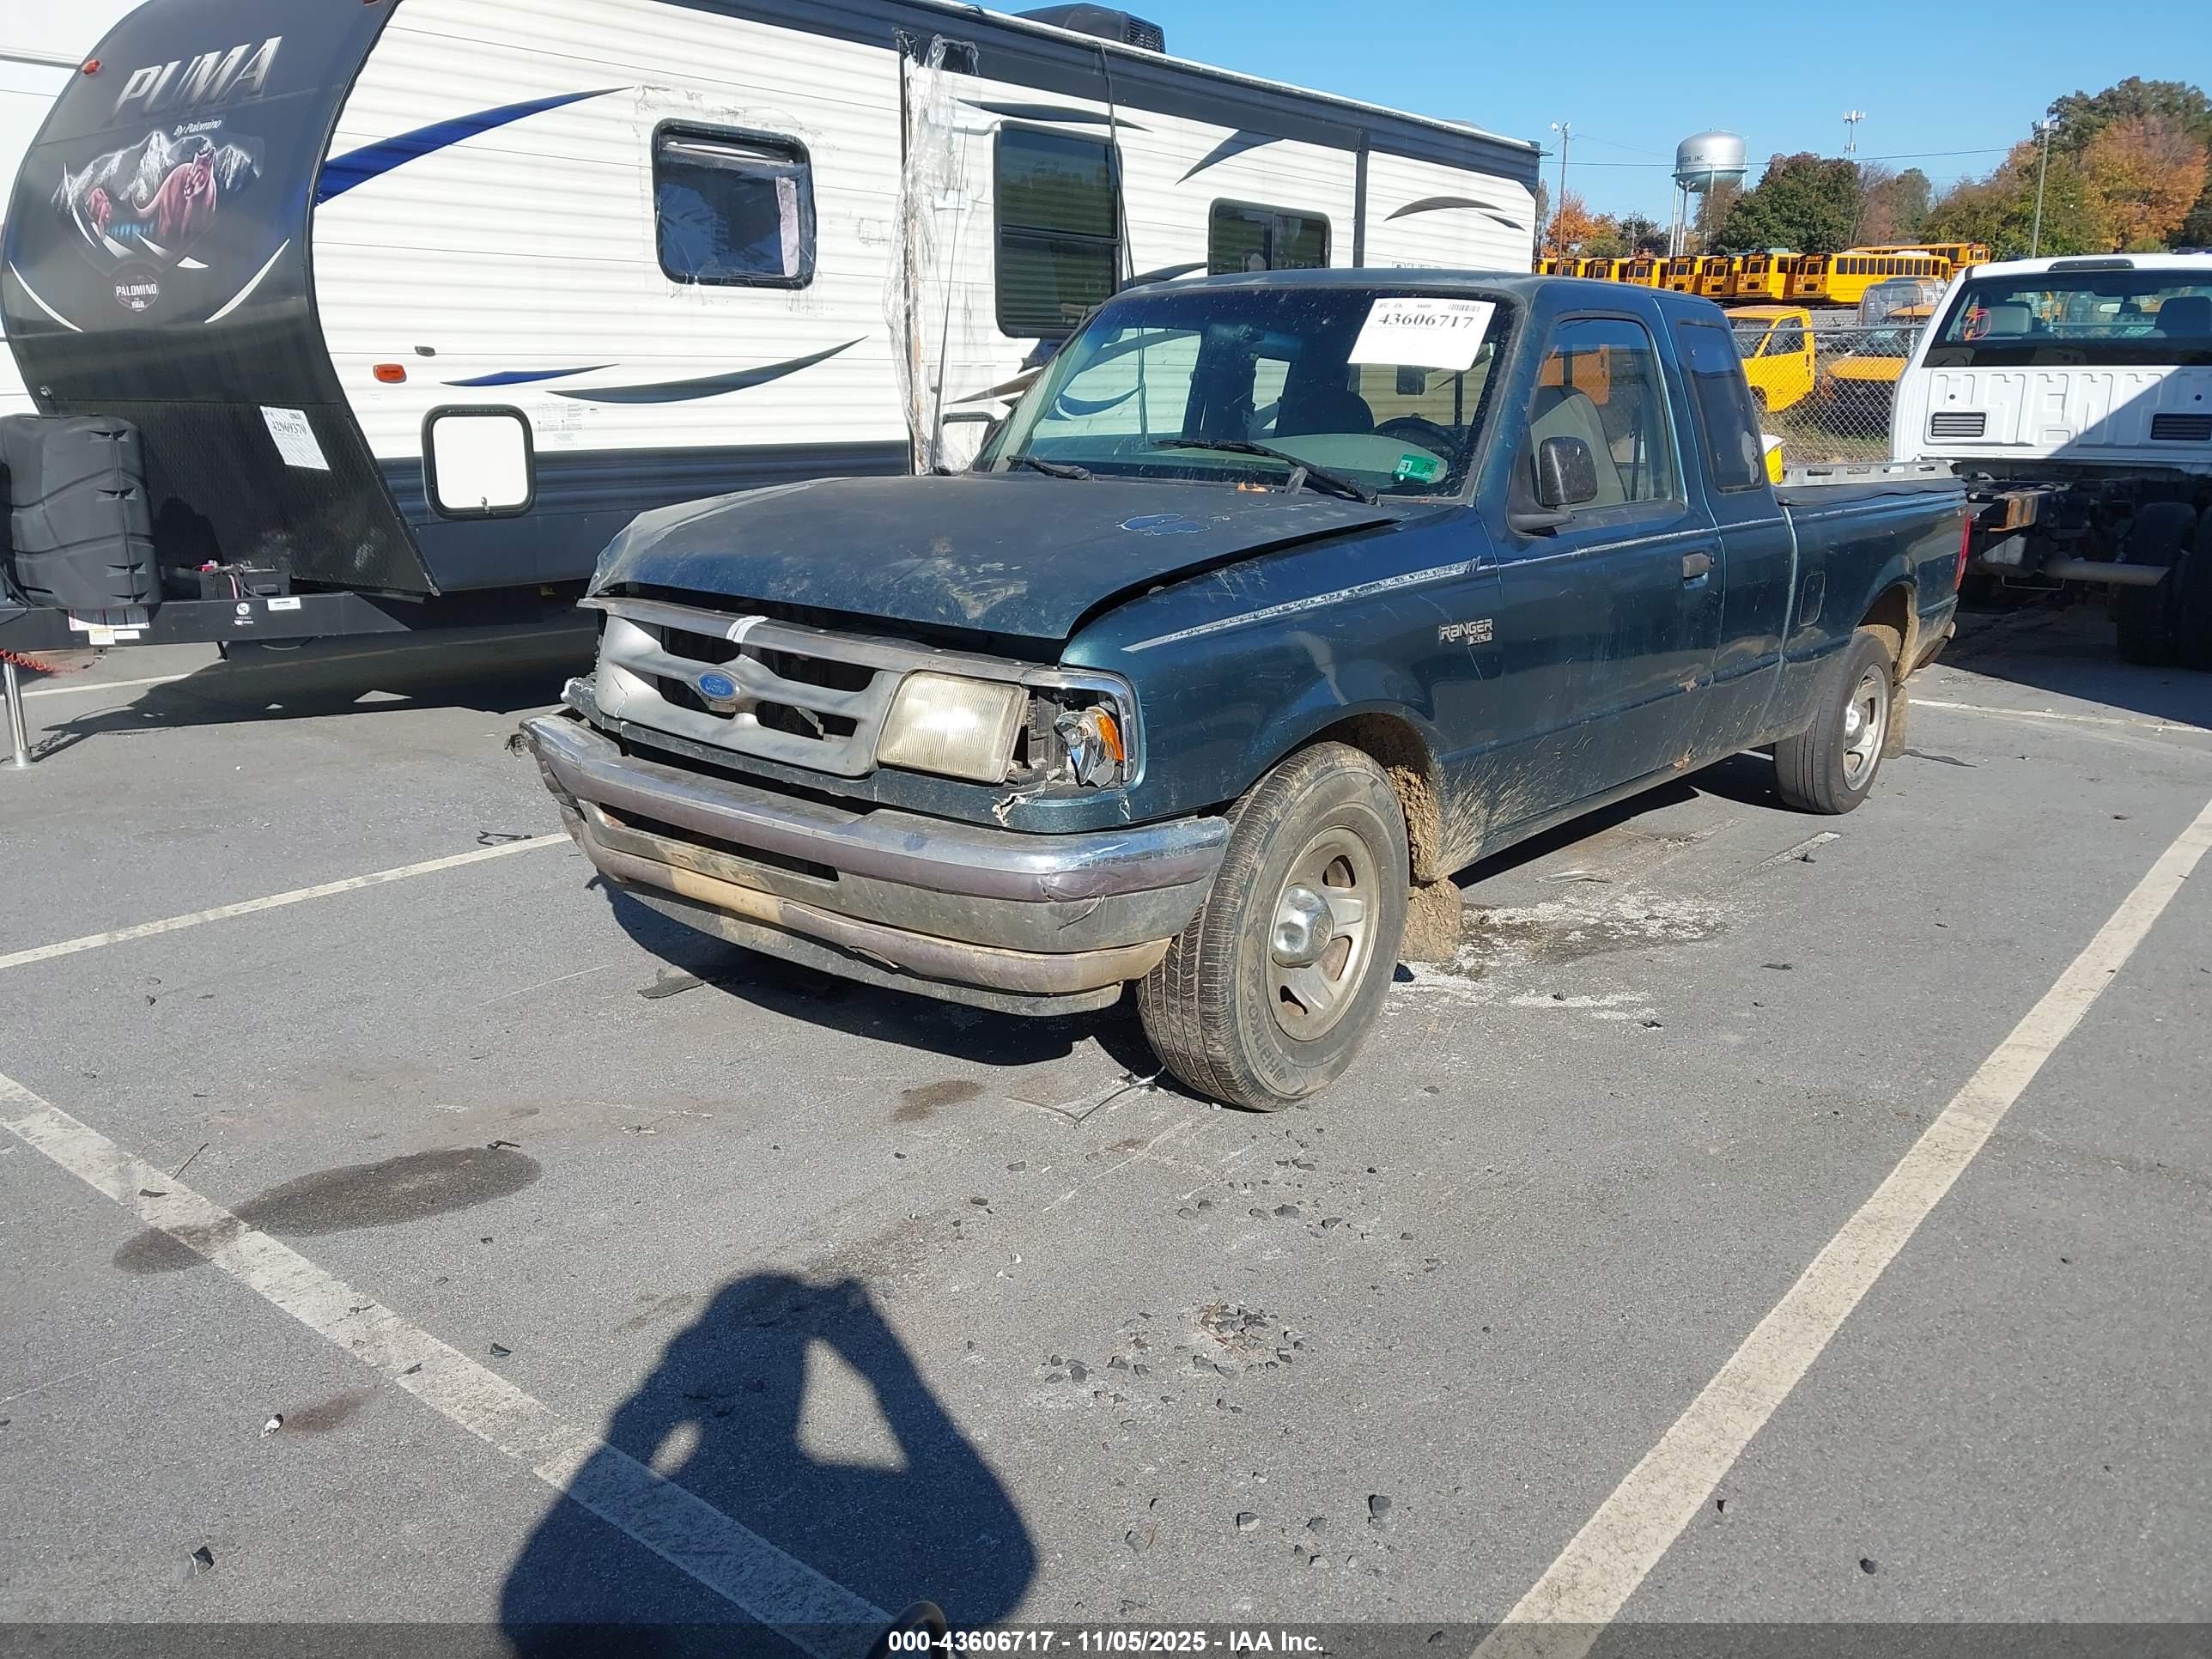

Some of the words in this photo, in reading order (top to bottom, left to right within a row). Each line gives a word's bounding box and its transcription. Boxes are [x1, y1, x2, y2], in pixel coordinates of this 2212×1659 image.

[112, 36, 283, 115] PUMA
[185, 119, 222, 133] Palomino
[115, 283, 157, 297] PALOMINO
[1377, 313, 1475, 329] 43606717
[1438, 618, 1493, 642] RANGER
[1471, 634, 1490, 643] XLT
